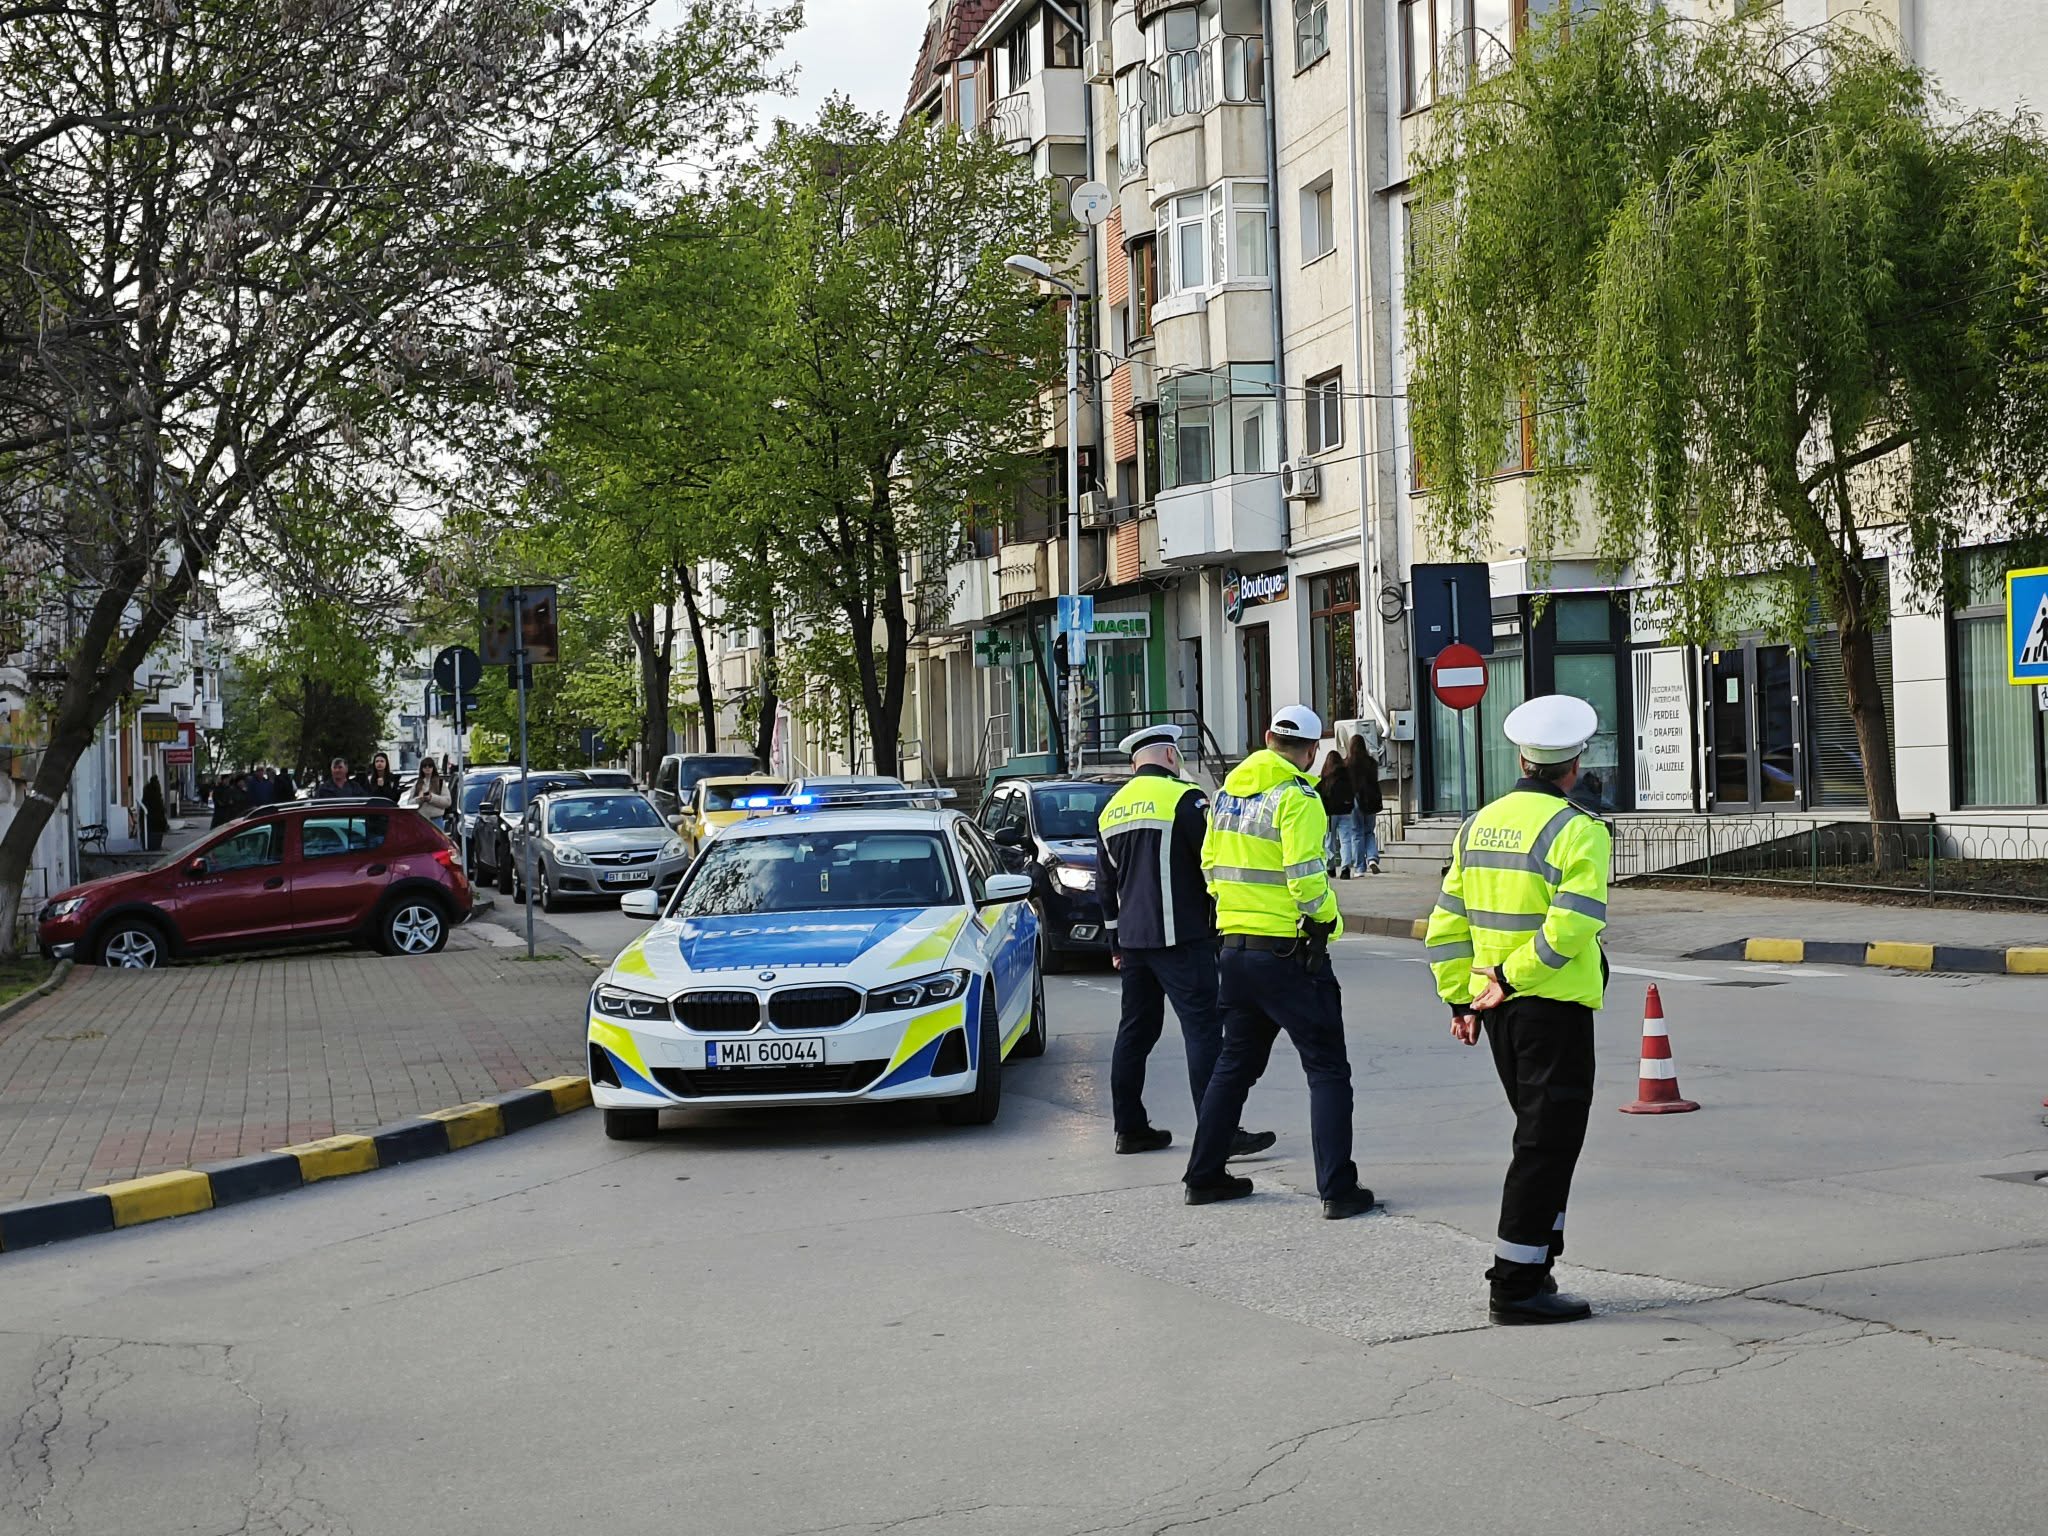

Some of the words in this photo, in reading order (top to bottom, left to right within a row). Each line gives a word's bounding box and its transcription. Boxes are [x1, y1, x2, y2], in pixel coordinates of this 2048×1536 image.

[1241, 573, 1282, 601] Boutique
[1093, 618, 1147, 633] MACIE
[1634, 617, 1674, 632] Concep
[1653, 709, 1680, 720] PERDELE
[1653, 727, 1683, 737] DRAPERII
[1654, 744, 1680, 754] GALERII
[1655, 761, 1685, 771] JALUZELE
[1639, 791, 1664, 801] servicii
[1665, 790, 1694, 803] comple
[1474, 838, 1519, 848] LOCALA
[177, 878, 223, 888] STEPWAY
[722, 1043, 751, 1063] MAI
[758, 1041, 818, 1062] 60044
